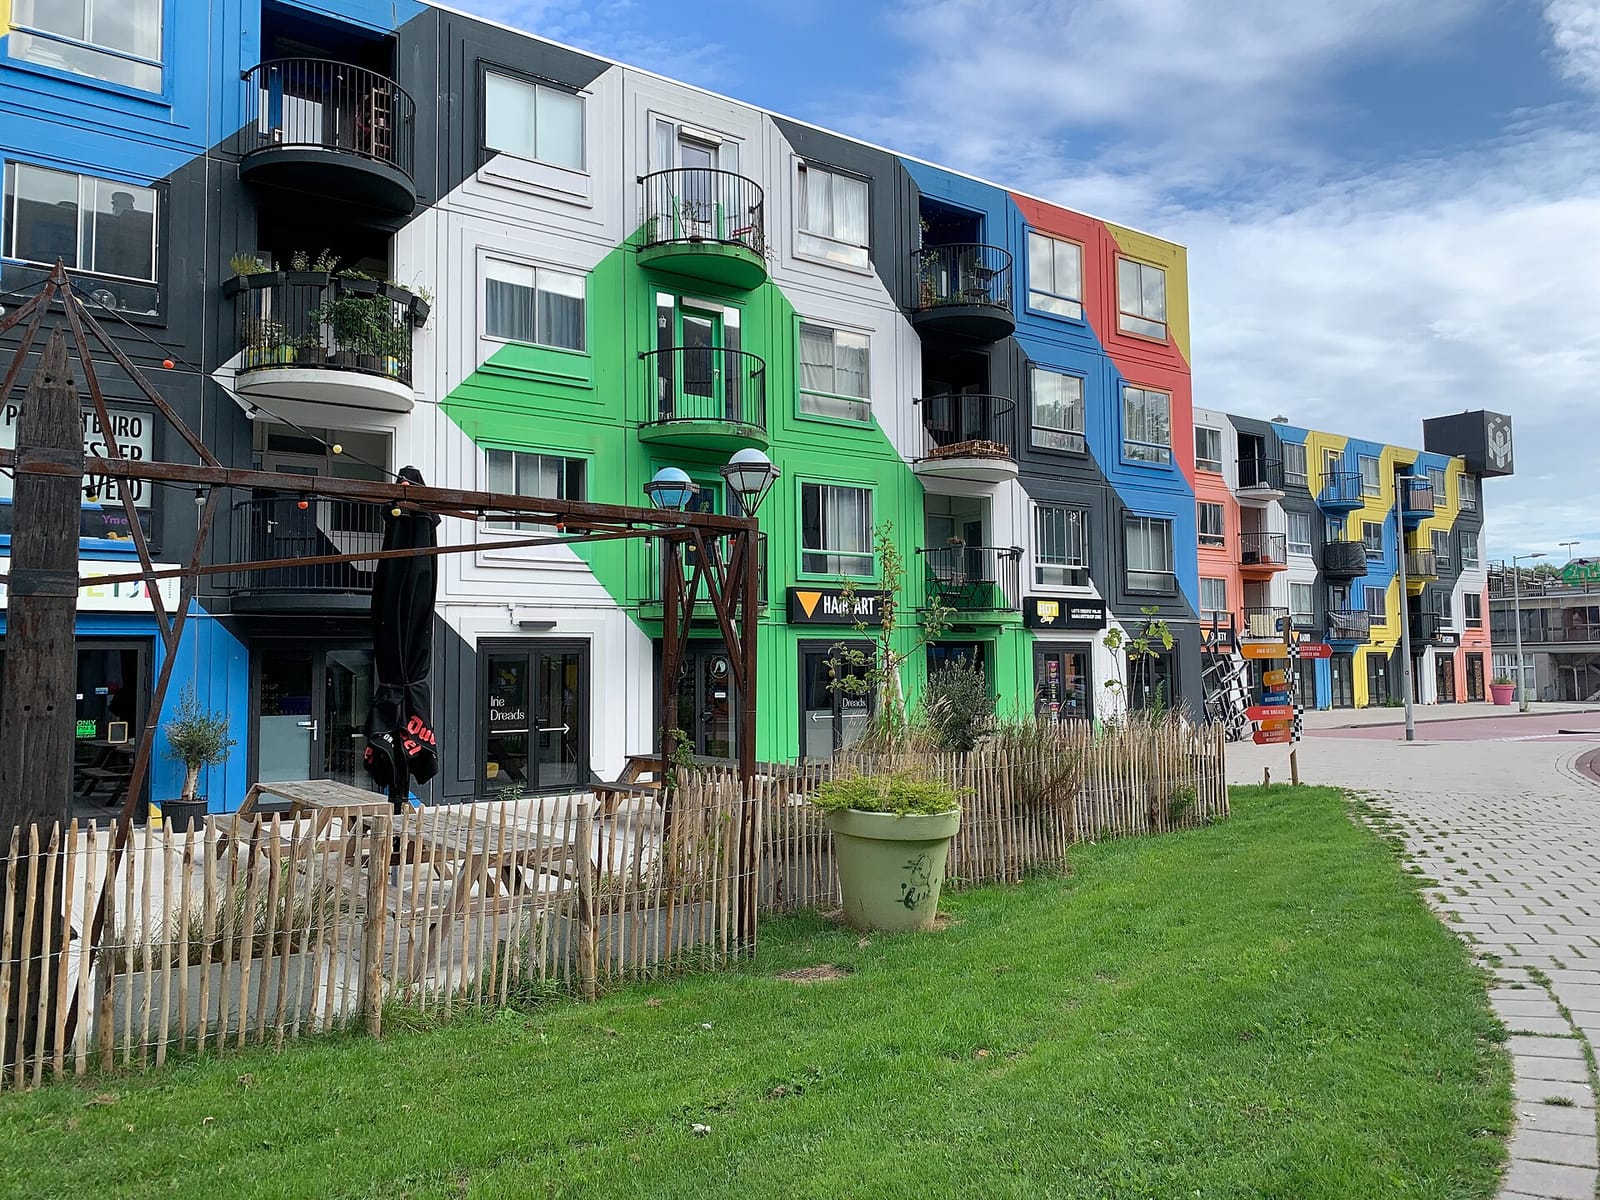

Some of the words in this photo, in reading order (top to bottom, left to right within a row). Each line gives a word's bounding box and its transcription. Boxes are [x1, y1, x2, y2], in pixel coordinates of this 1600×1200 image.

[853, 596, 875, 615] ART
[490, 695, 505, 707] Irie
[842, 697, 866, 708] Dreads
[490, 708, 525, 721] Dreads
